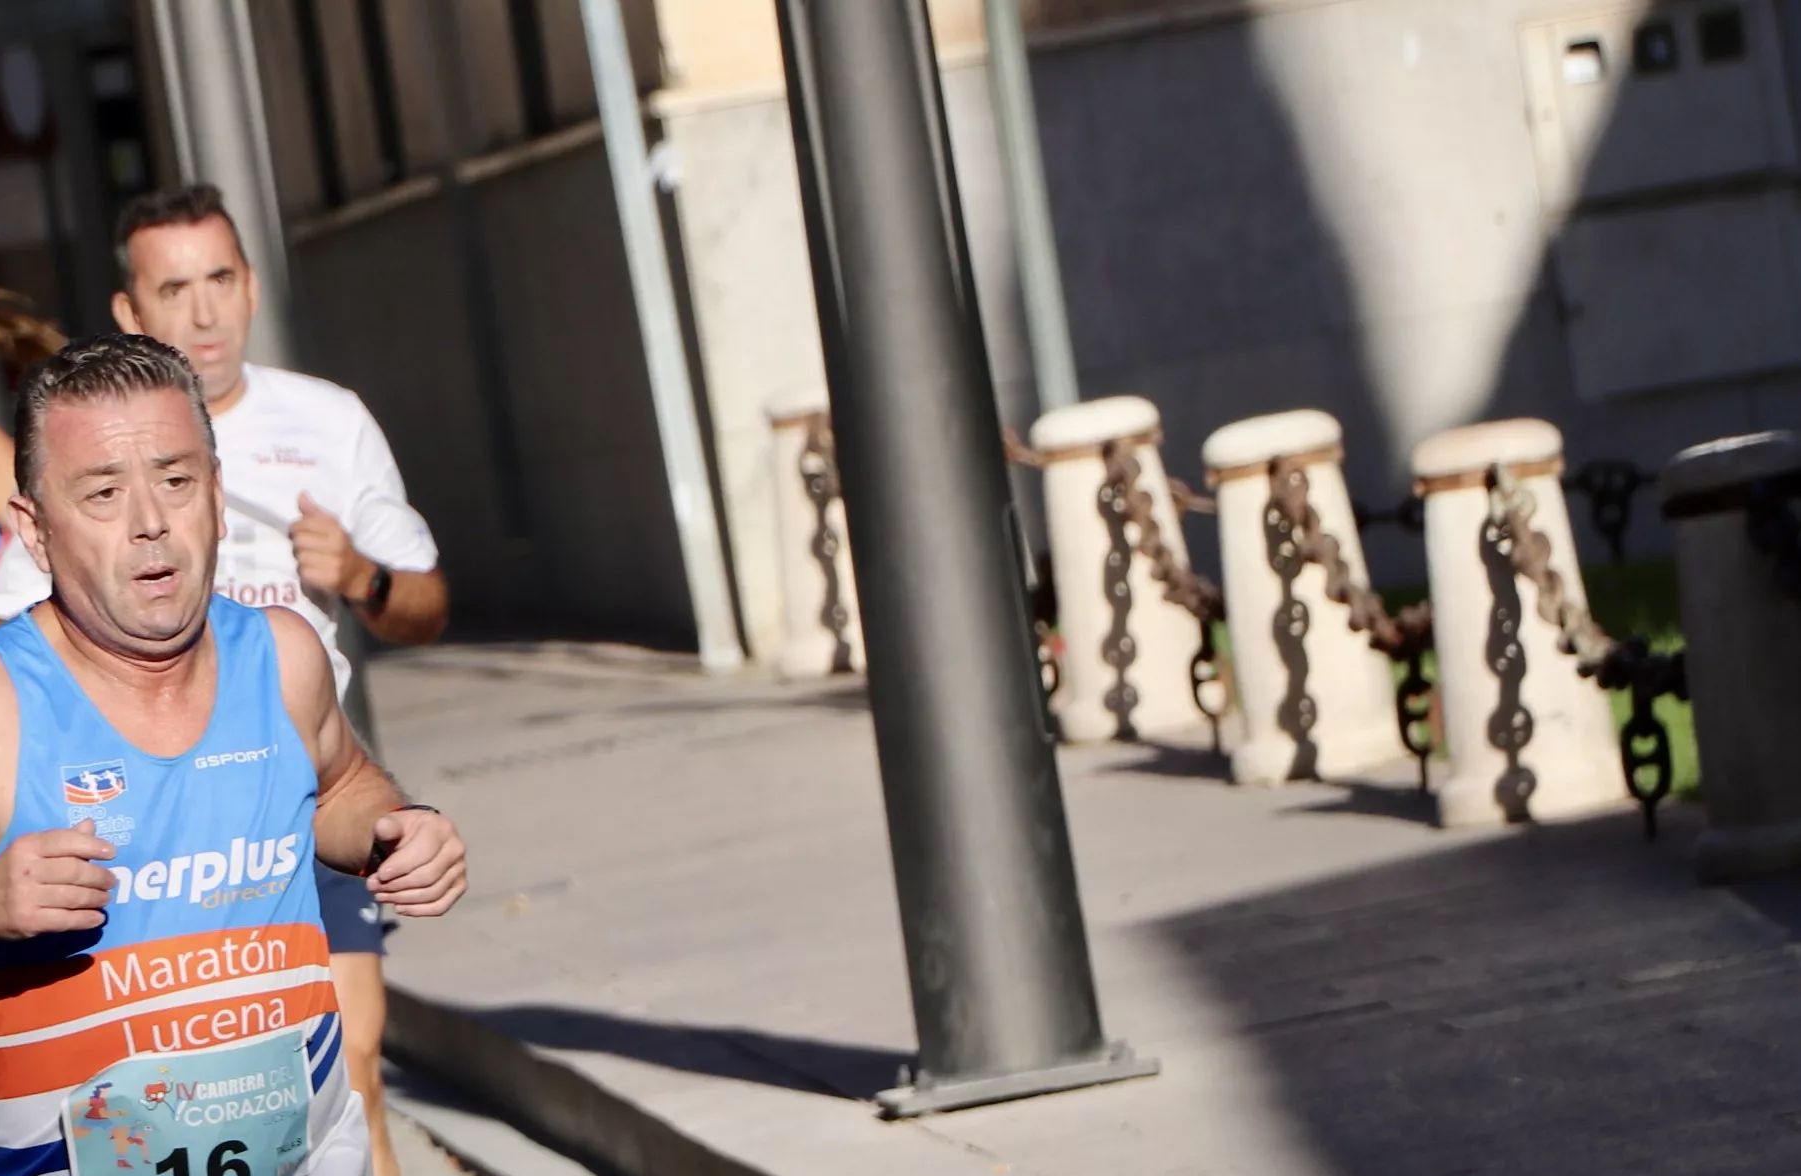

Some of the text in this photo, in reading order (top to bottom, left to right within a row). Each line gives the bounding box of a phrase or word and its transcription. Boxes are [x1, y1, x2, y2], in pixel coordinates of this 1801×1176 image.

[108, 833, 298, 905] nerplus
[100, 930, 284, 1001] Maratón
[122, 997, 287, 1057] Lucena
[197, 1073, 266, 1100] CARRERA
